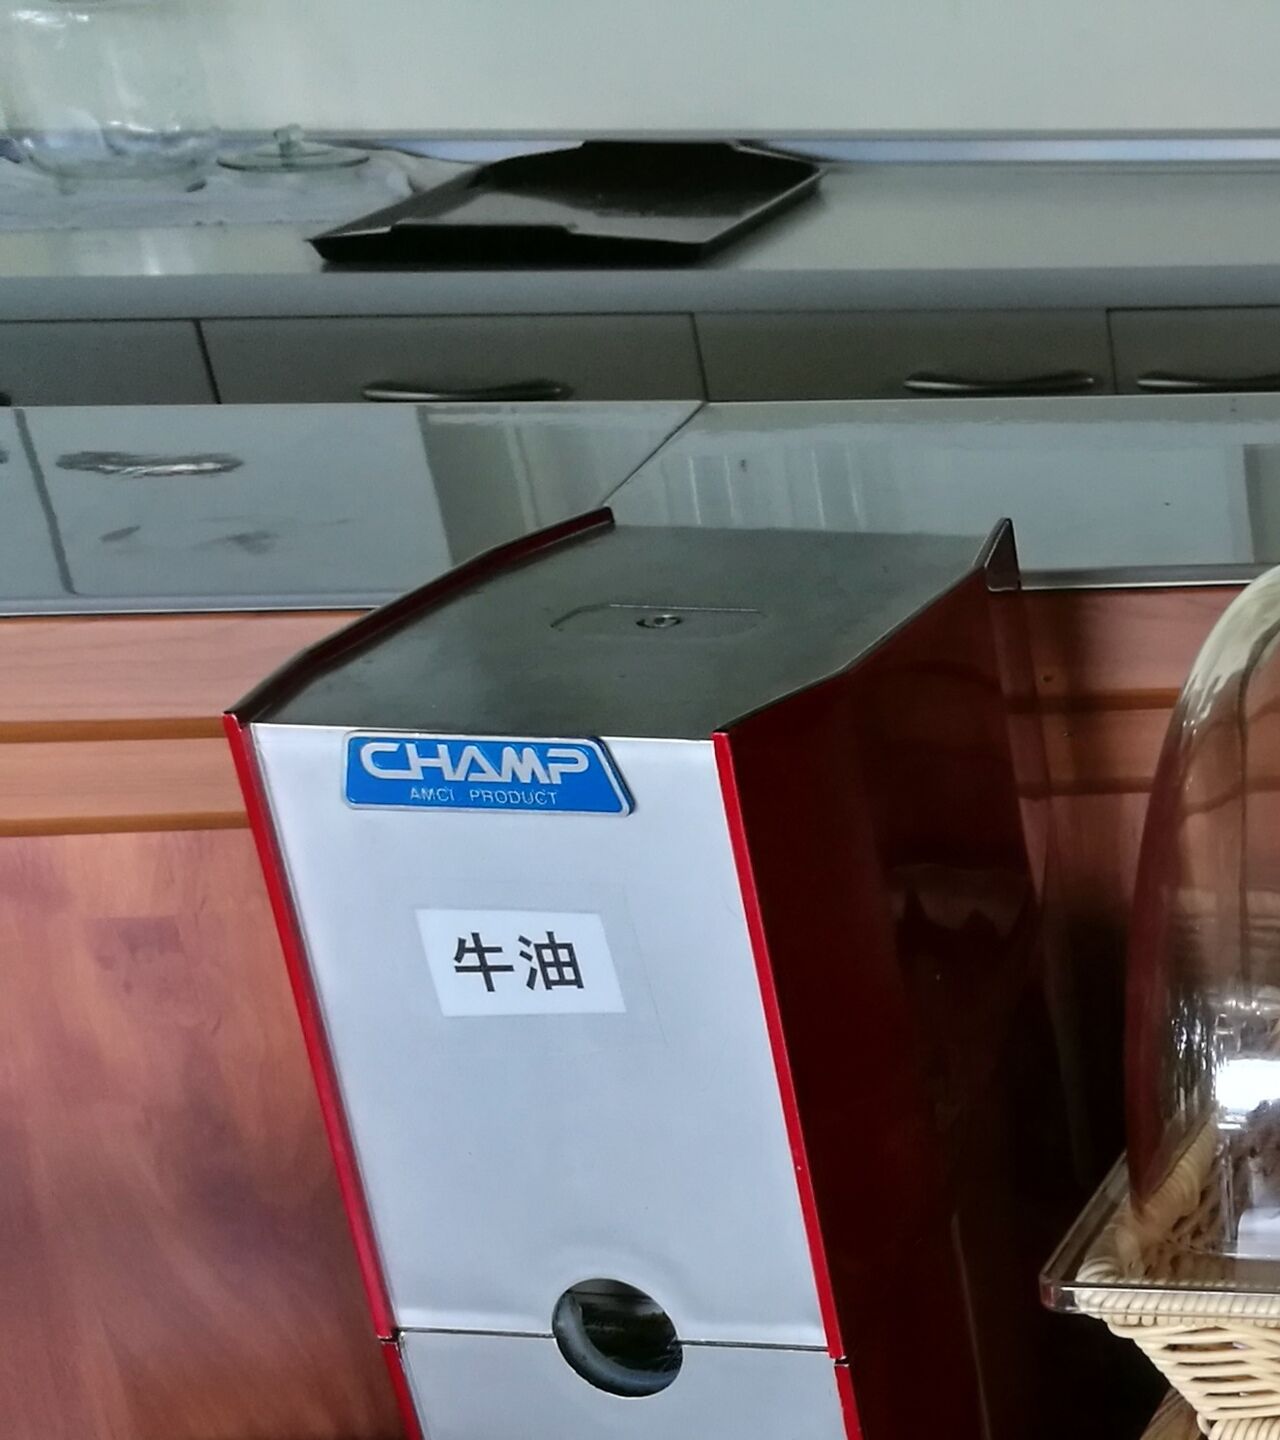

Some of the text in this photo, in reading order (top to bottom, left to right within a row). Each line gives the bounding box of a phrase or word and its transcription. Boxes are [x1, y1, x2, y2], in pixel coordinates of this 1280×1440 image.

[360, 741, 590, 785] CHAMP
[468, 788, 558, 805] PRODUCT
[453, 931, 584, 992] 牛油
